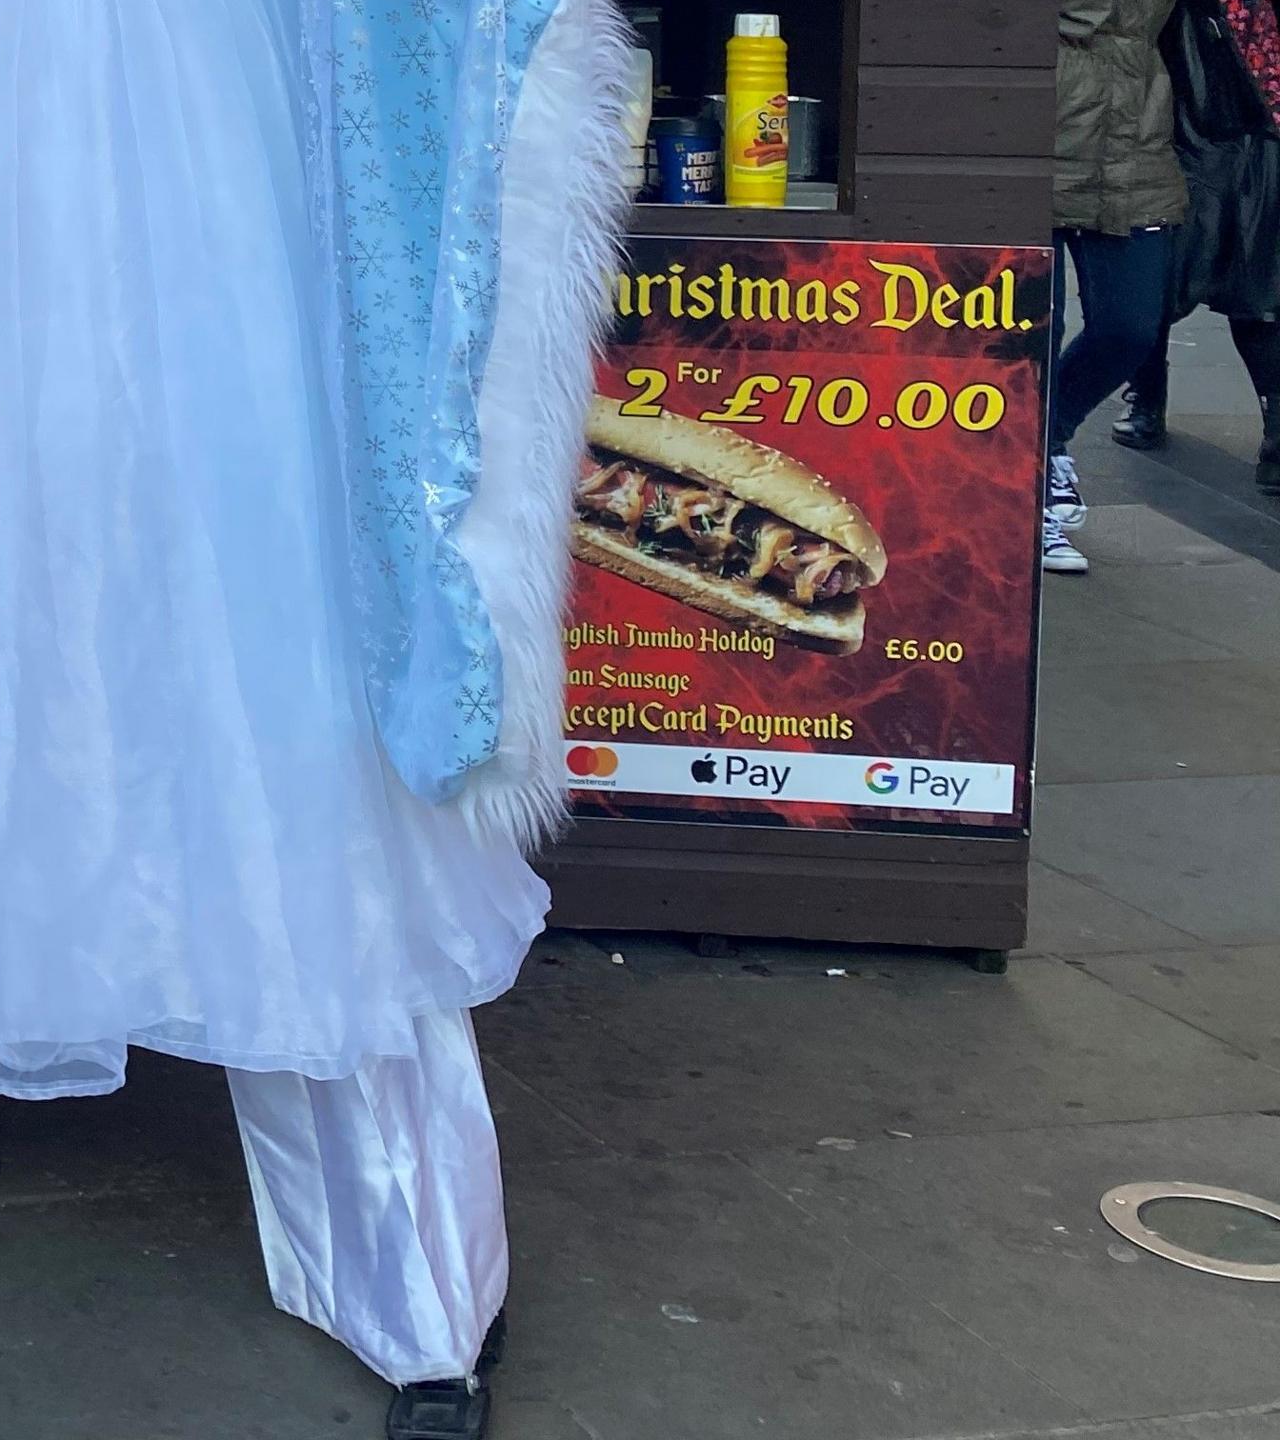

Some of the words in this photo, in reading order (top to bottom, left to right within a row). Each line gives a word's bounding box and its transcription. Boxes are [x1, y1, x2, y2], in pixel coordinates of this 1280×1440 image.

[867, 257, 1035, 332] Deal.
[619, 368, 669, 417] 2
[677, 362, 722, 385] For
[699, 375, 1007, 432] £10.00
[624, 623, 695, 651] Jumbo
[696, 624, 775, 660] Hotdog
[885, 638, 963, 663] £6.00
[598, 663, 690, 696] Sausage
[640, 702, 707, 733] Card
[715, 703, 854, 744] Payments
[725, 755, 791, 795] Pay
[909, 766, 970, 806] Pay
